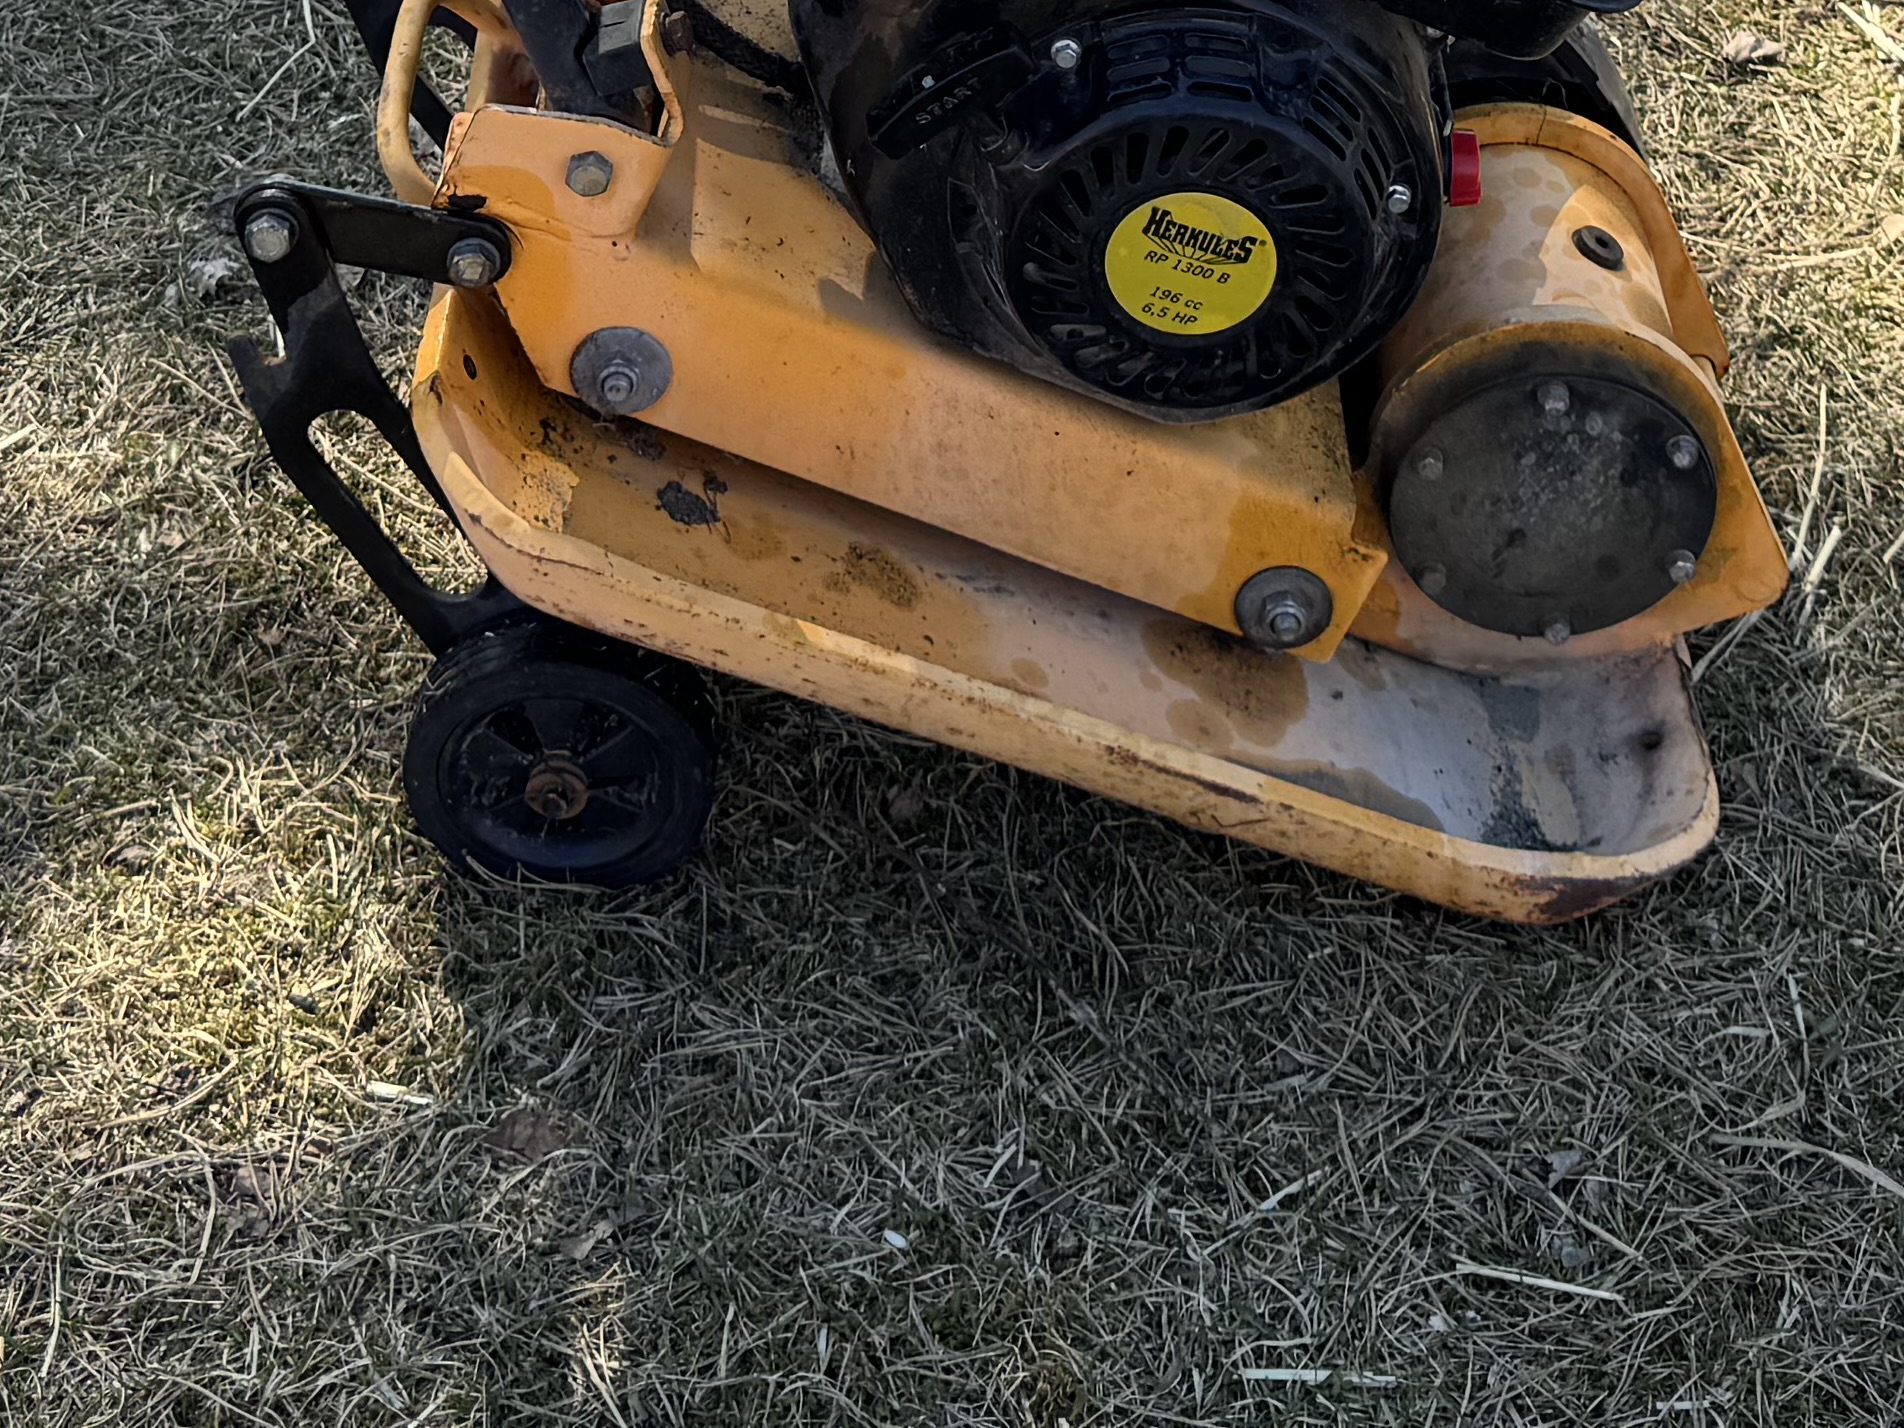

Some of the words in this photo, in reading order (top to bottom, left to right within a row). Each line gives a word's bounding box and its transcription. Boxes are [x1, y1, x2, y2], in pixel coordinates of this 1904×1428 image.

[915, 76, 981, 124] START
[1142, 206, 1259, 265] HERKULES
[1144, 250, 1169, 265] RP
[1172, 259, 1215, 280] 1300
[1216, 272, 1231, 284] B
[1149, 286, 1183, 304] 196
[1184, 299, 1203, 311] cc
[1171, 311, 1199, 326] HP
